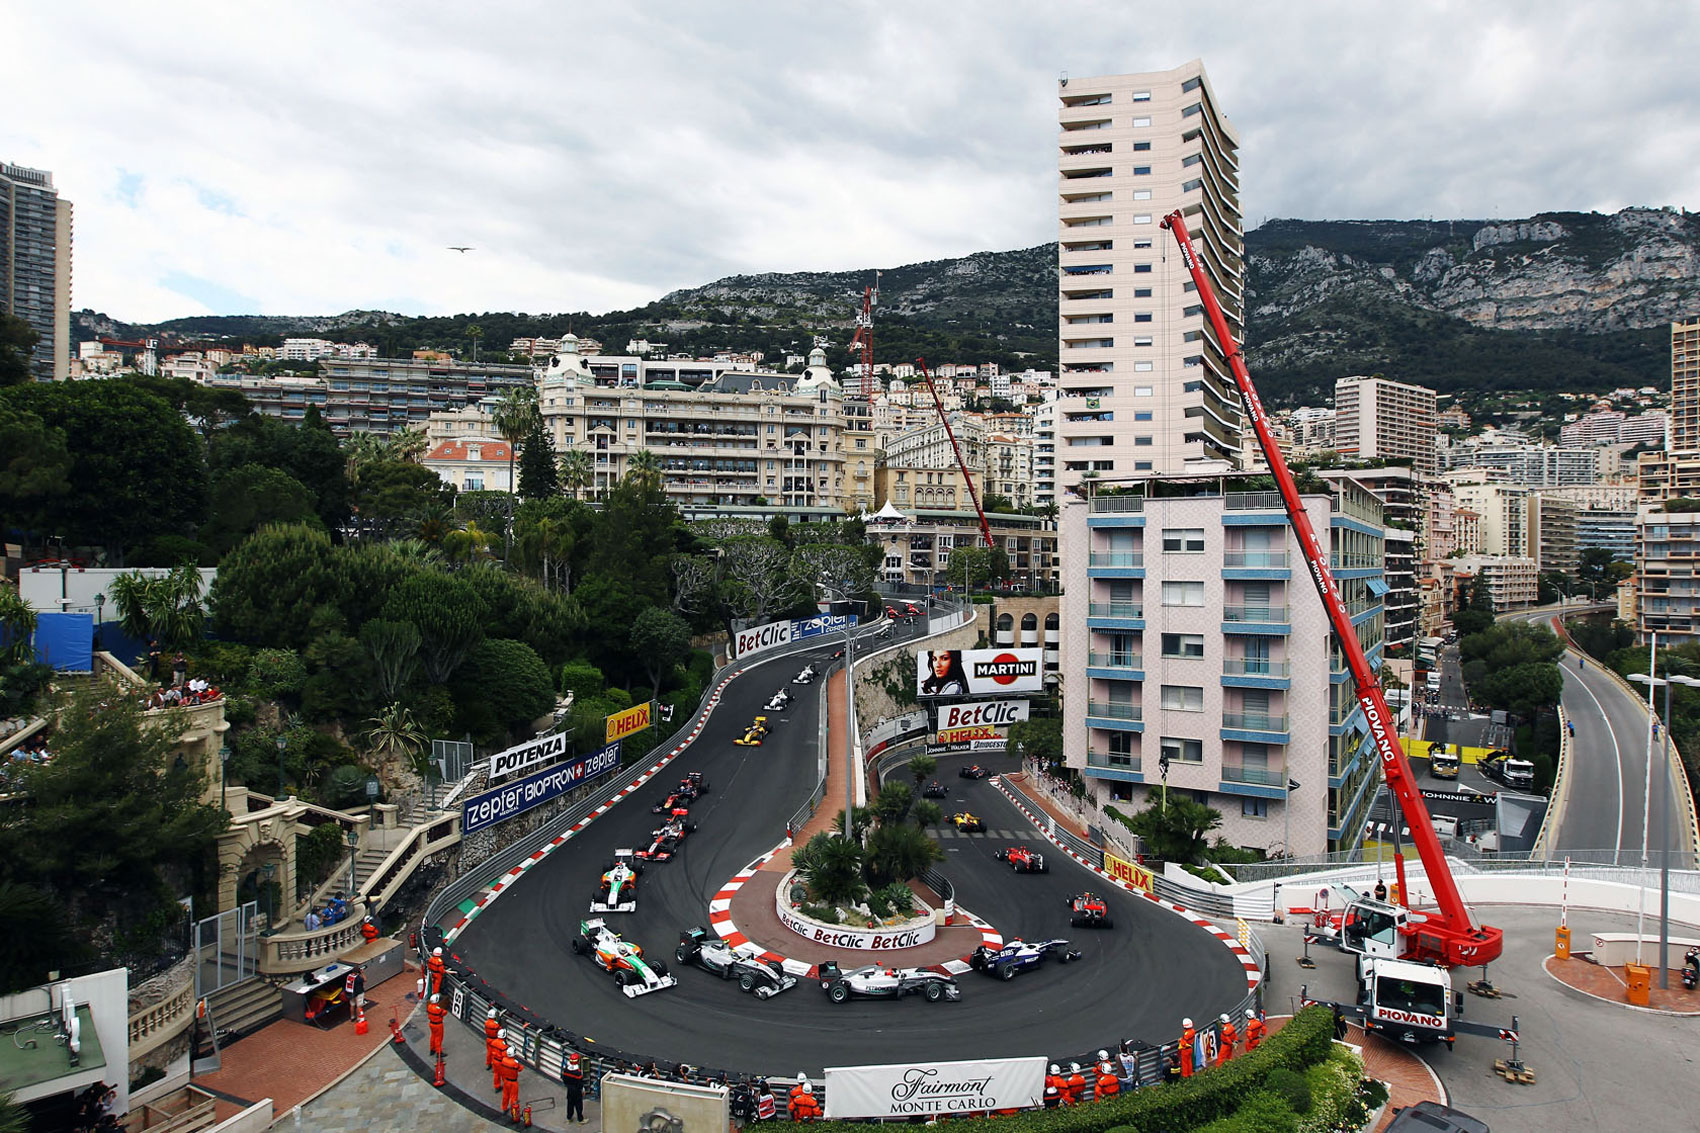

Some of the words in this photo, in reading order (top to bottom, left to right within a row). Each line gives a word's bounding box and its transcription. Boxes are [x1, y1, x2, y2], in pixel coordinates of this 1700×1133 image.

[1311, 559, 1328, 594] PIOVANO
[739, 623, 788, 655] BetClic
[977, 663, 1033, 676] MARTINI
[617, 708, 648, 735] HELIX
[947, 702, 1019, 727] BetClic
[1361, 696, 1395, 762] PIOVANO
[495, 738, 562, 773] POTENZA
[469, 787, 523, 824] zepter
[525, 766, 575, 801] BIOPTRON
[586, 746, 618, 773] zepter
[1113, 860, 1150, 890] HELIX
[782, 913, 808, 936] BetClic
[813, 928, 864, 948] BetClic
[870, 931, 920, 949] BetClic
[1379, 1008, 1442, 1028] PIOVANO
[891, 1068, 995, 1101] Fairmont
[890, 1100, 942, 1113] MONTE
[947, 1097, 996, 1110] CARLO
